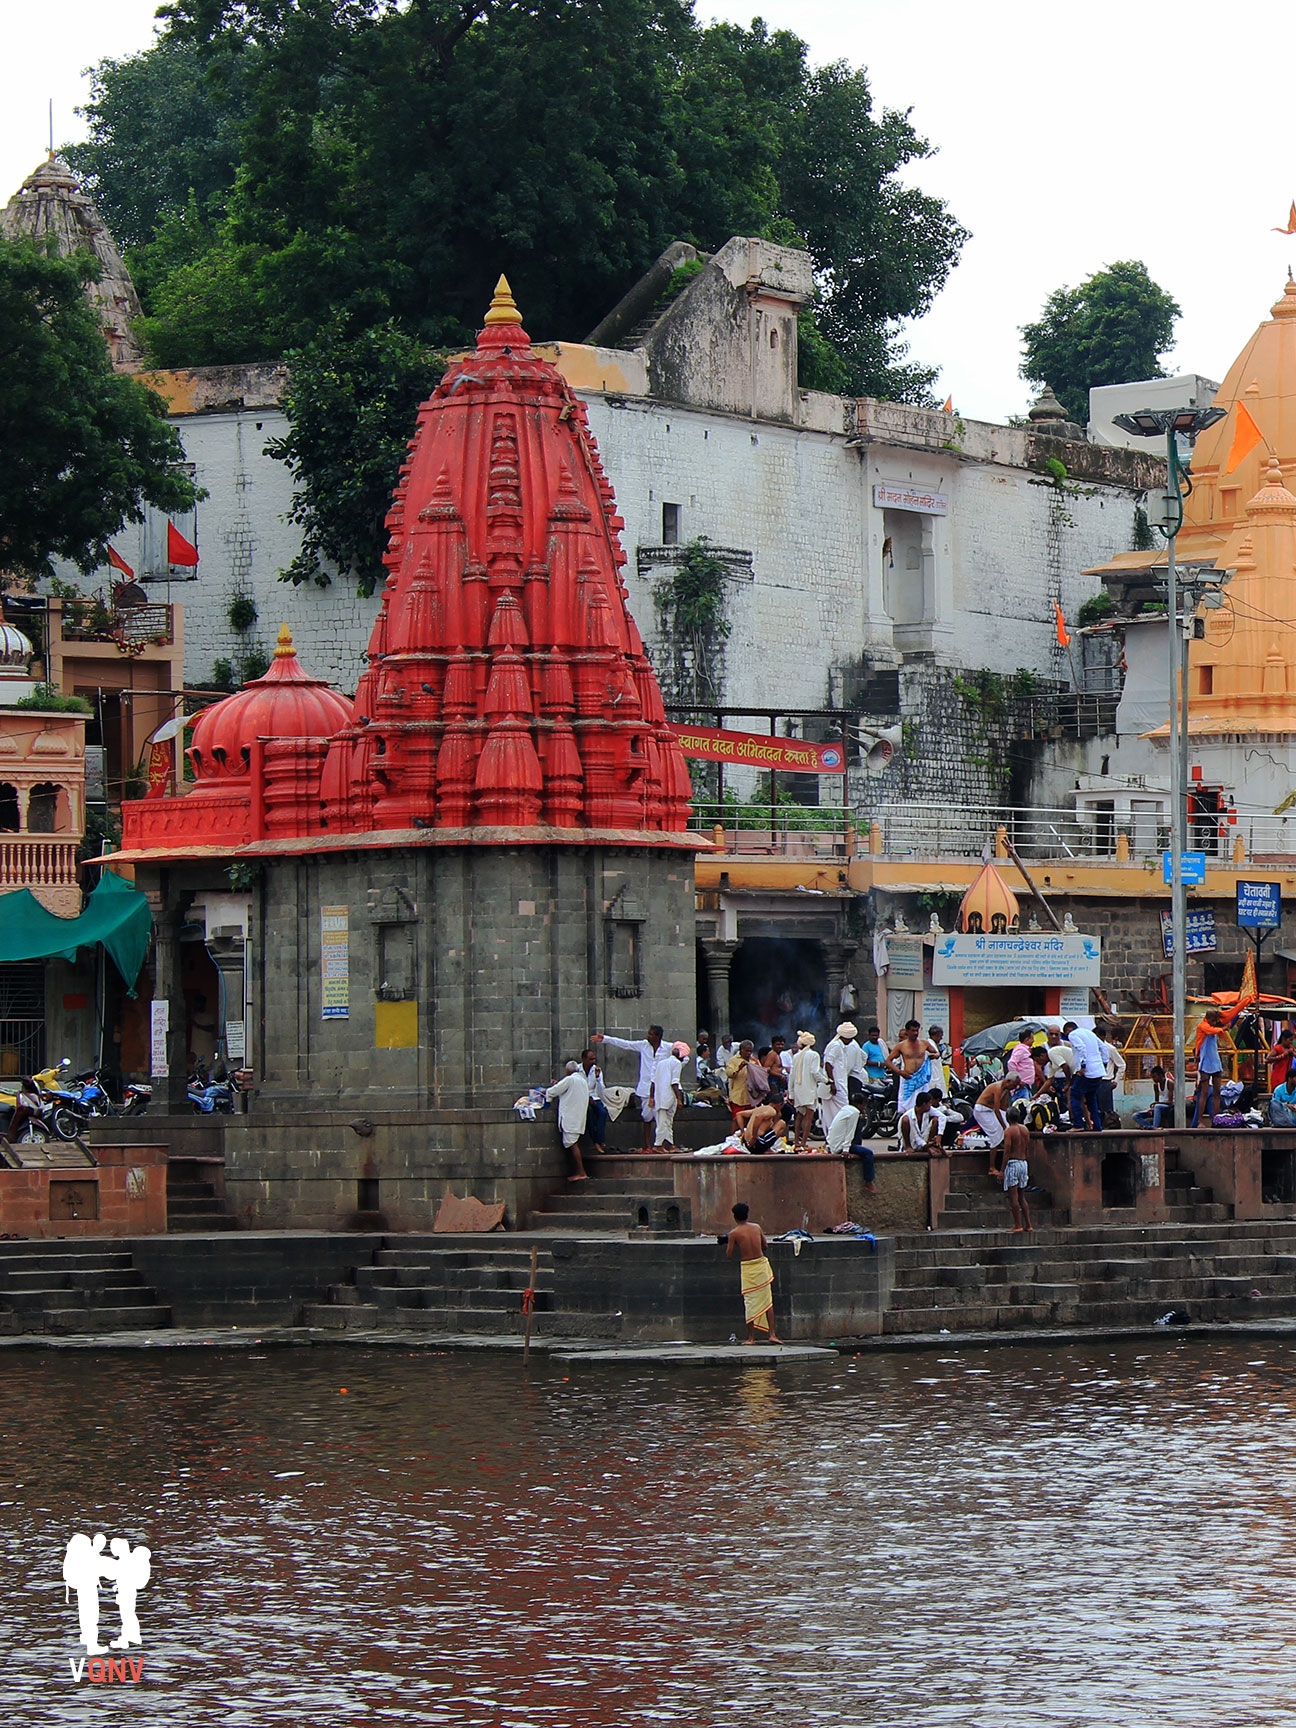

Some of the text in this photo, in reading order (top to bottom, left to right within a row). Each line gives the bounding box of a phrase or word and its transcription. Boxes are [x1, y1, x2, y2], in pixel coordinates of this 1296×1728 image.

[678, 733, 818, 768] स्वागत वंदन अभिनंदन करता है
[1243, 882, 1271, 898] चेतावनी
[975, 937, 1064, 952] श्री नागचन्द्रेश्वर मंदिर
